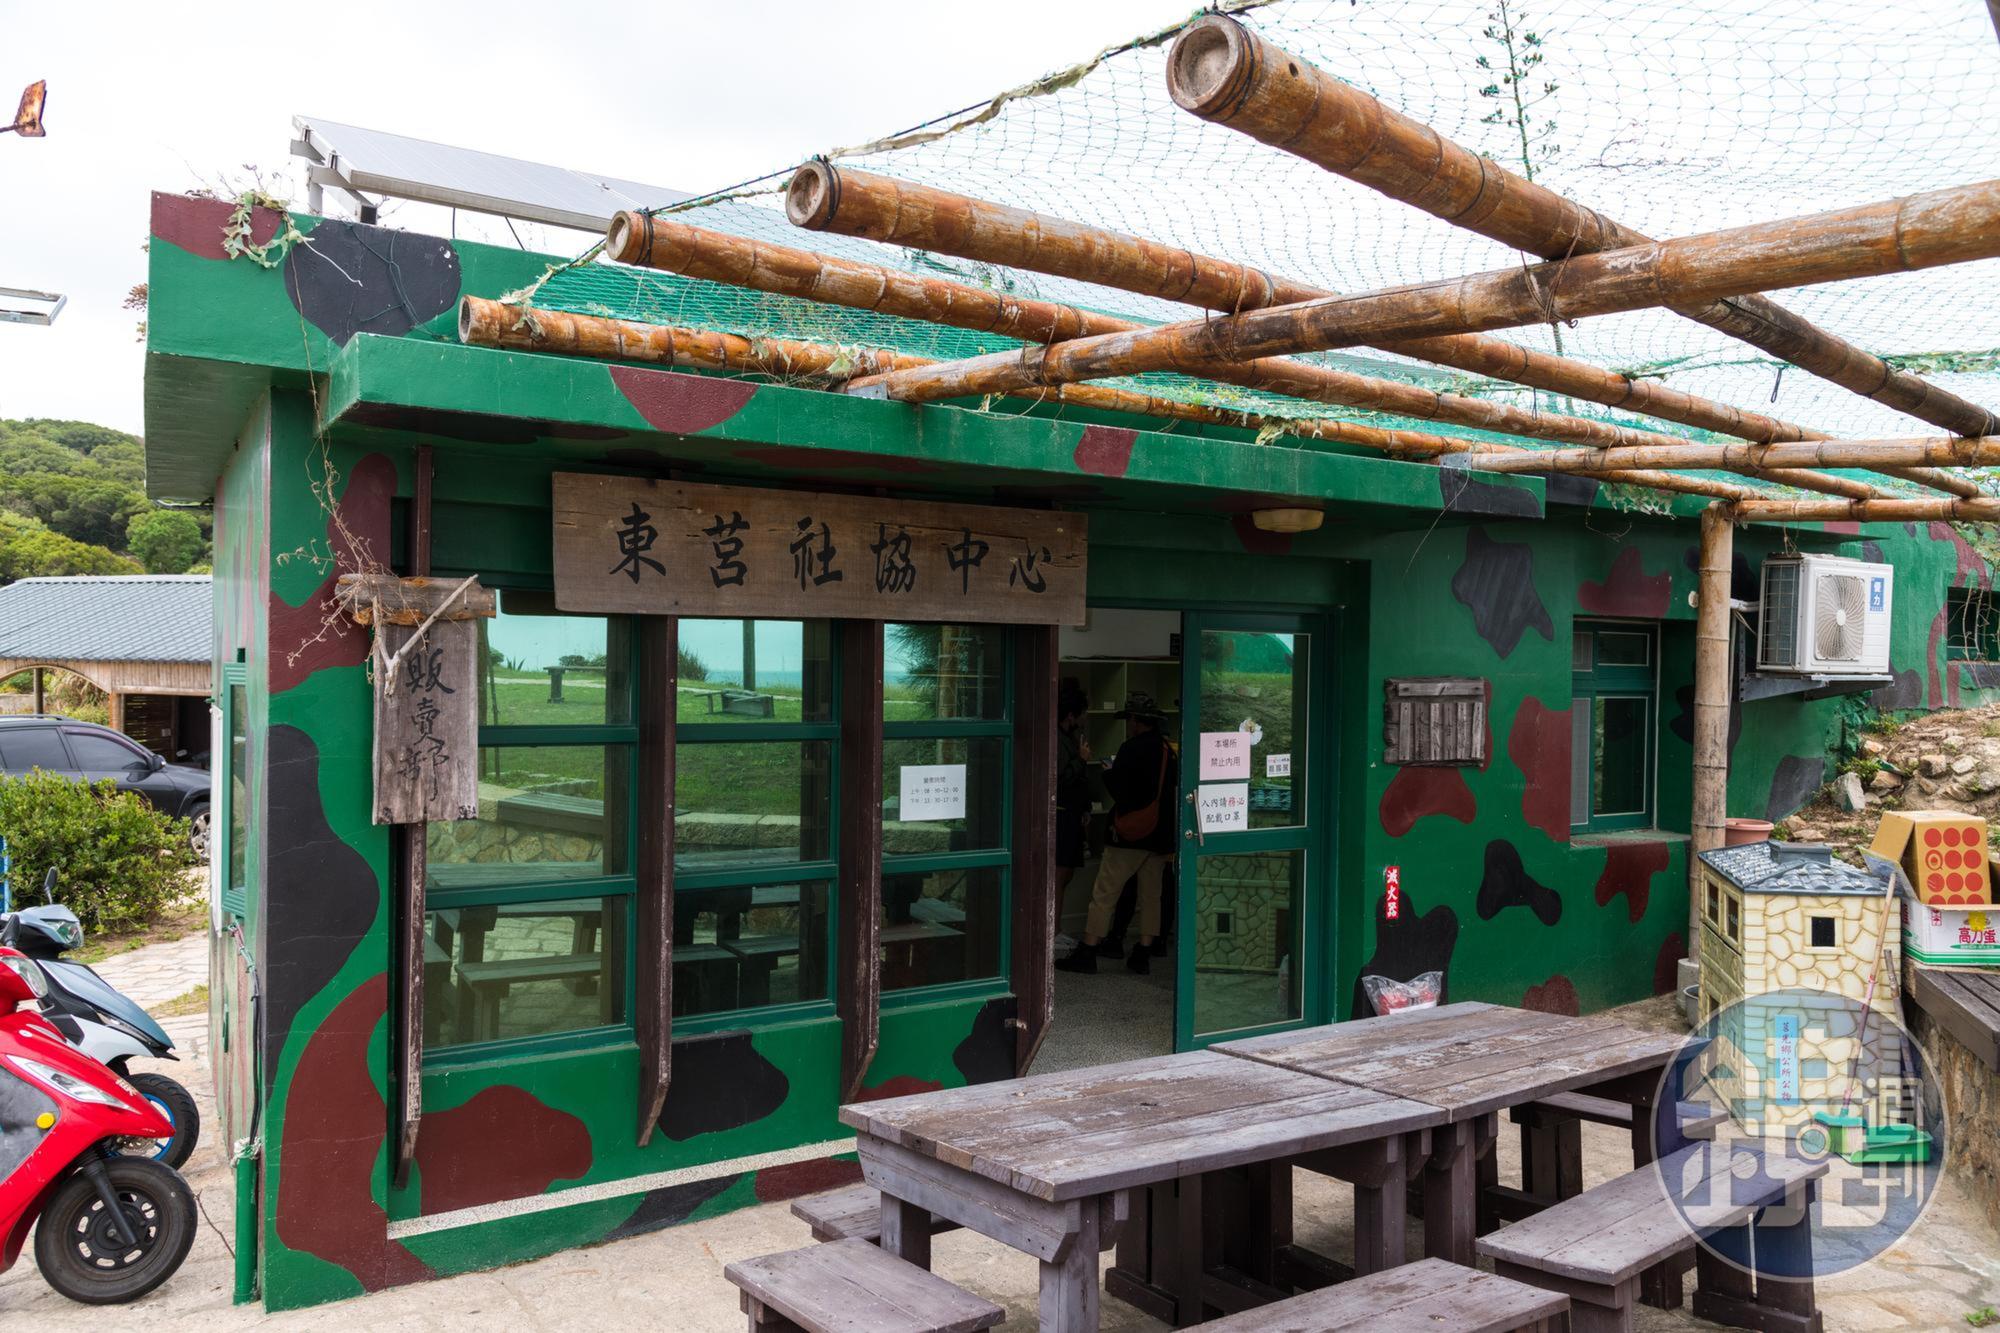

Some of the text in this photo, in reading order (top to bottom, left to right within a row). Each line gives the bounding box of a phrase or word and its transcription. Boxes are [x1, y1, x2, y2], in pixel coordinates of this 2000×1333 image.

[609, 502, 1052, 595] 東莒社協中心
[397, 648, 456, 802] 販賣部
[1386, 868, 1399, 918] 滅火器
